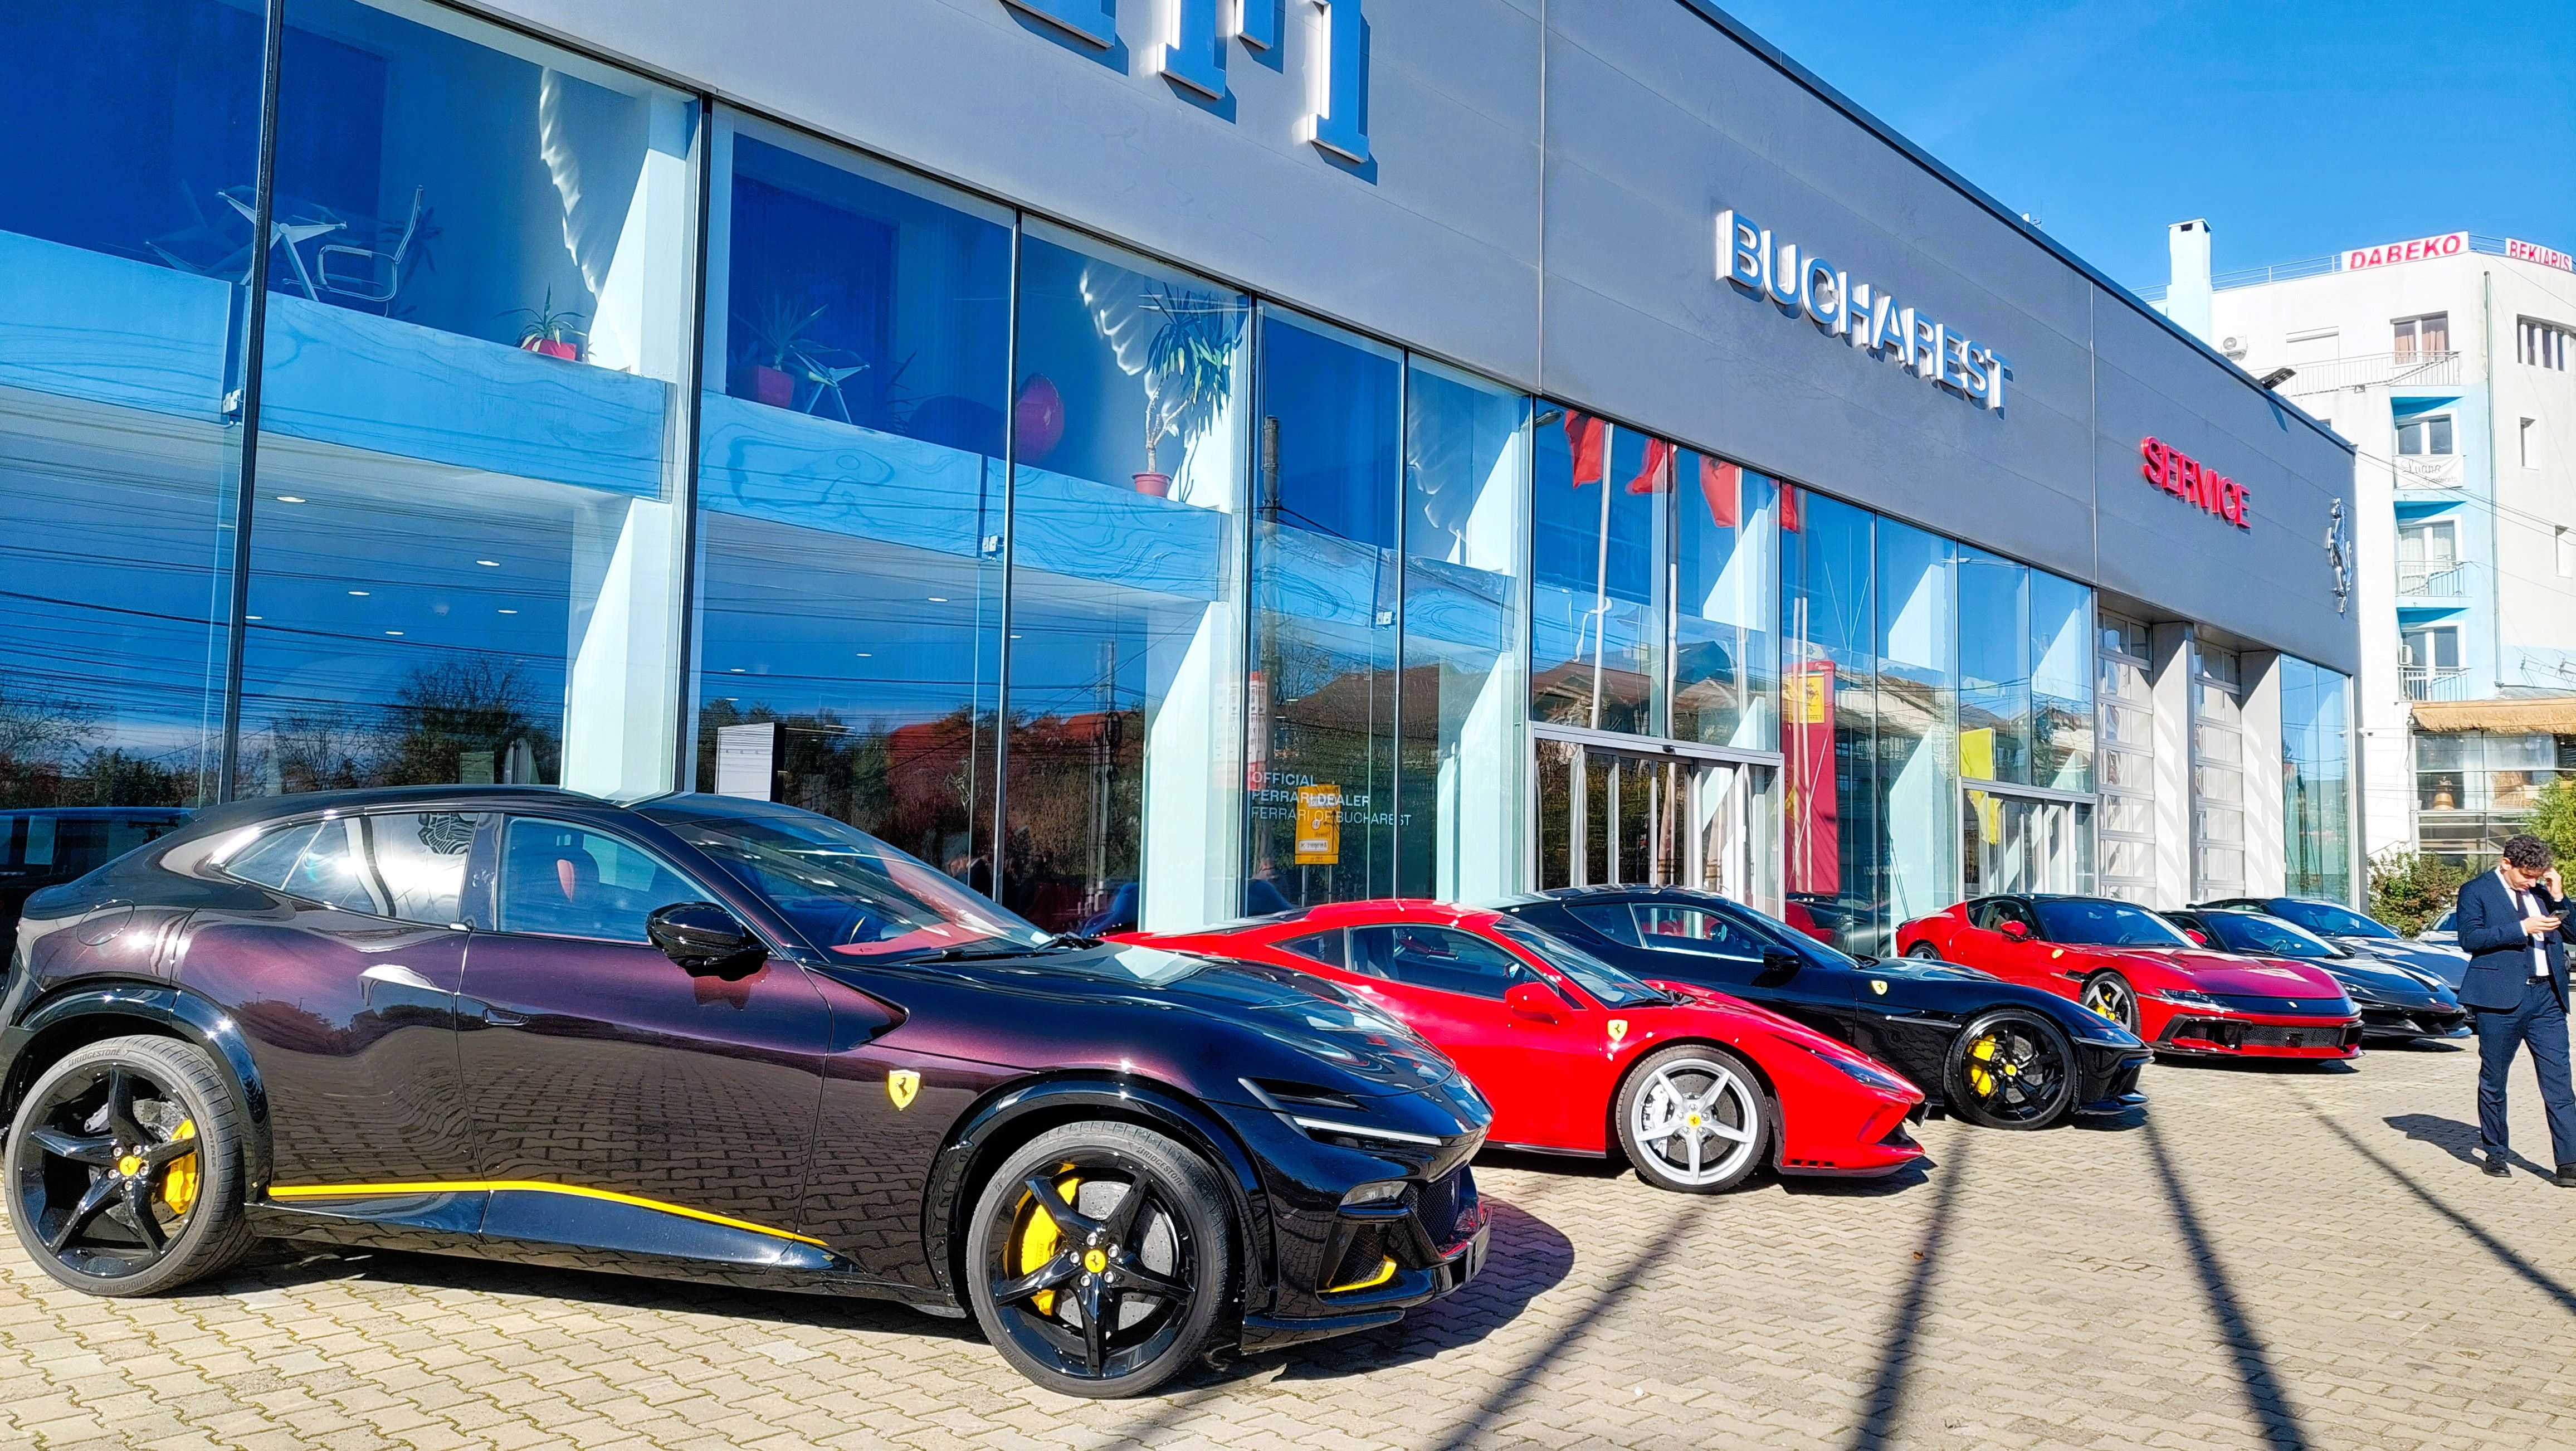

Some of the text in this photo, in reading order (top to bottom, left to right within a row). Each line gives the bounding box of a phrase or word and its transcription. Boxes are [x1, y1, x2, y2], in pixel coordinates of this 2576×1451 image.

[2350, 235, 2461, 270] DABEKO
[1725, 210, 2013, 408] BUCHAREST
[2141, 436, 2251, 528] SERVICE
[1253, 771, 1318, 786] OFFICIAL
[1252, 790, 1313, 805] FERRARI
[1318, 793, 1369, 806] DEALER
[1251, 807, 1309, 821] FERRARI
[1314, 810, 1332, 822] OF
[68, 1049, 121, 1068] BRIDGESTONE
[1136, 1146, 1185, 1187] BRIDGESTONE
